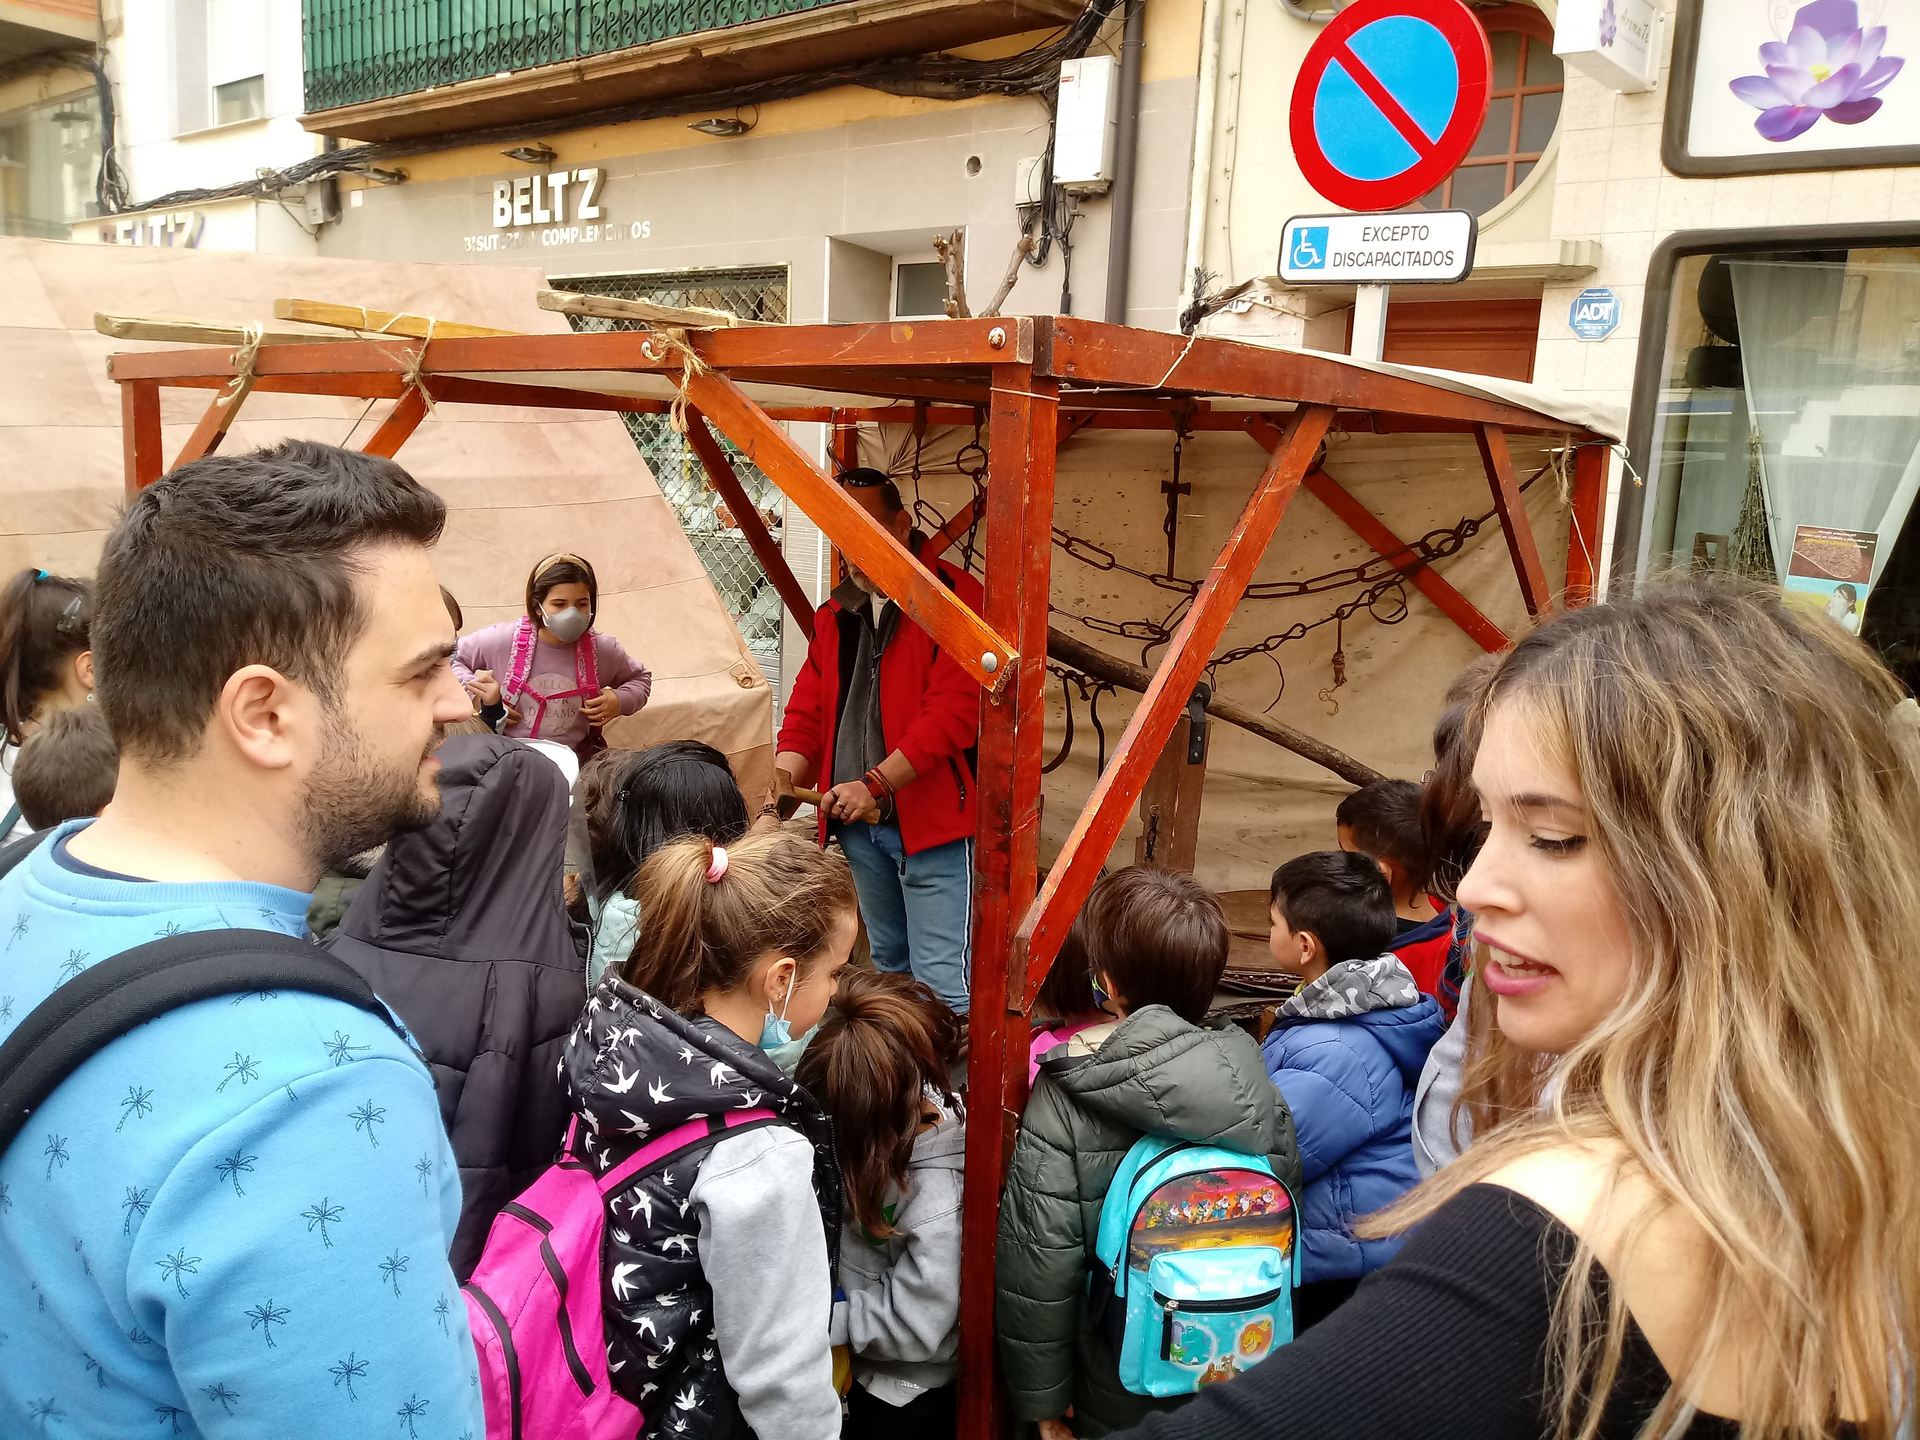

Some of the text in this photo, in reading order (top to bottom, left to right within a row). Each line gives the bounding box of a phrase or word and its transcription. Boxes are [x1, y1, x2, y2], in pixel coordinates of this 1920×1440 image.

[493, 167, 603, 228] BELT'Z
[541, 220, 651, 247] COMPLEMENTOS
[1362, 225, 1430, 242] EXCEPTO
[1332, 250, 1454, 267] DISCAPACITADOS
[1576, 303, 1612, 320] ADT
[528, 706, 576, 719] DEAMS
